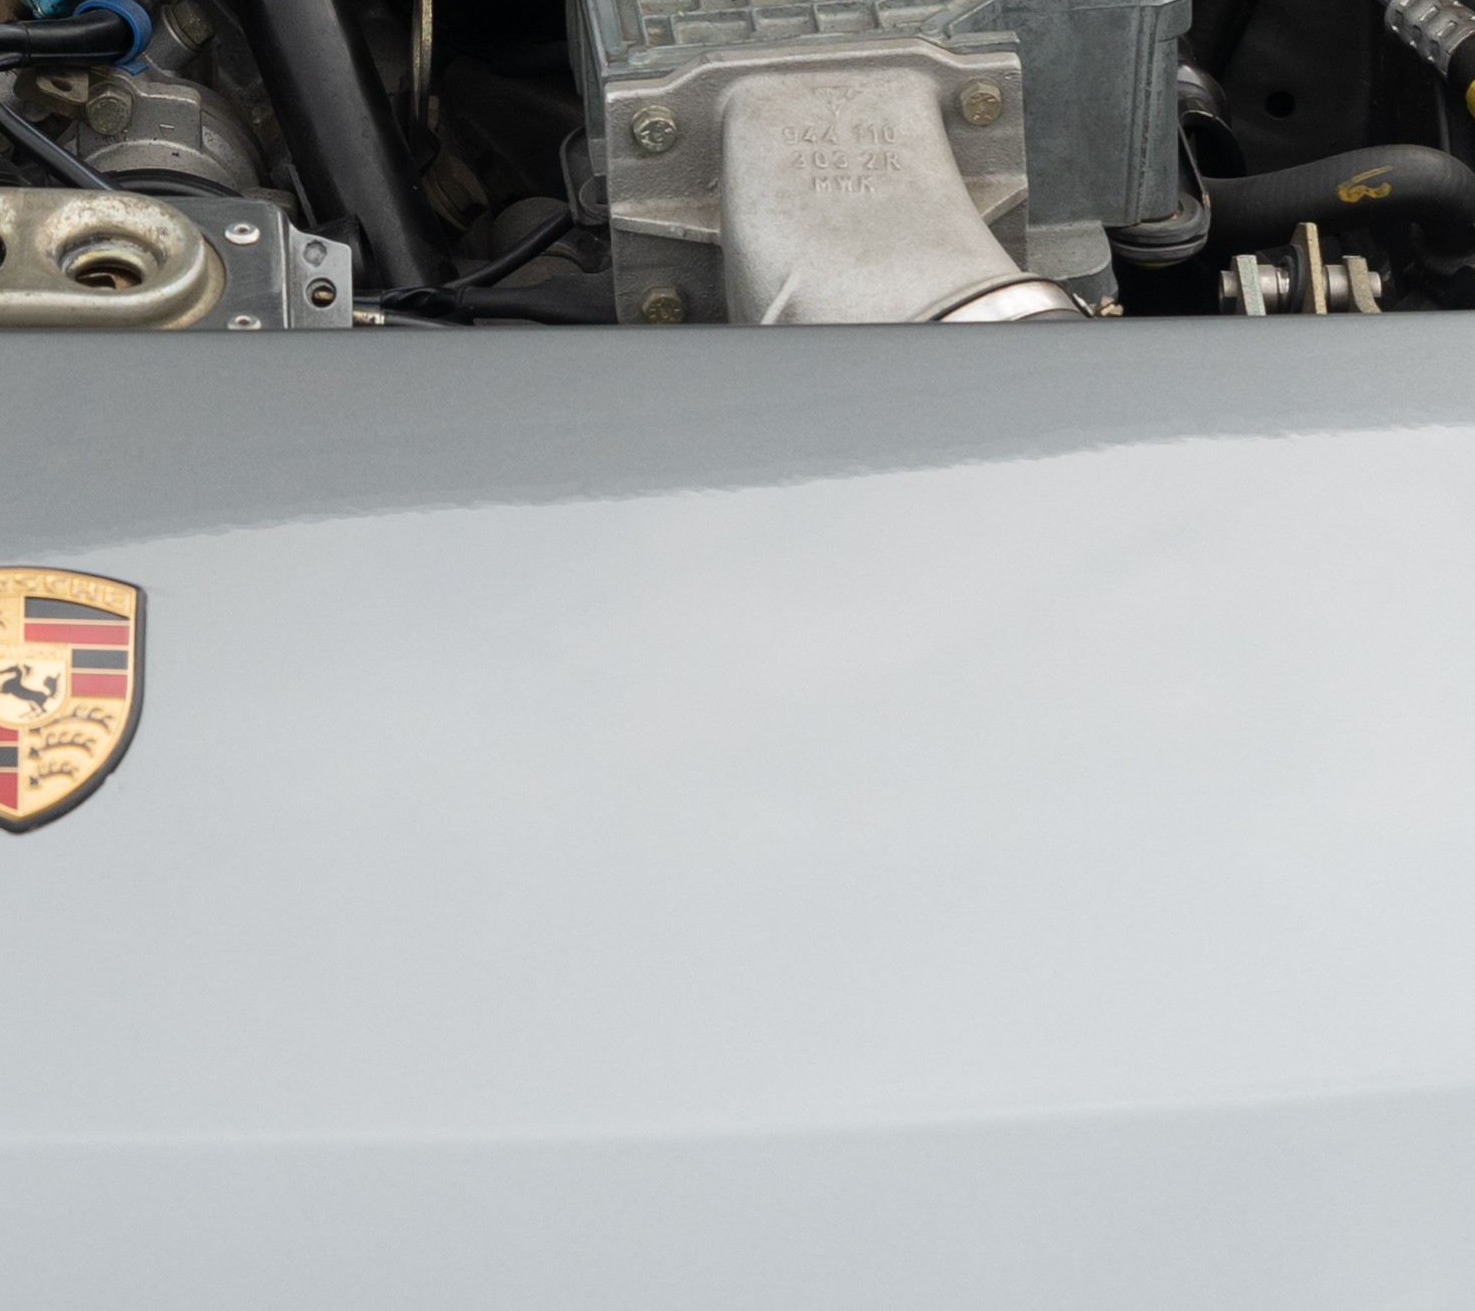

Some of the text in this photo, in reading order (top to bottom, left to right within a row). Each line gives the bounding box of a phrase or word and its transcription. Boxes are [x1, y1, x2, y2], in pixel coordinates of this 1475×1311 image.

[781, 121, 898, 147] 944 110
[790, 149, 902, 173] 303 2R
[811, 174, 877, 196] MWK
